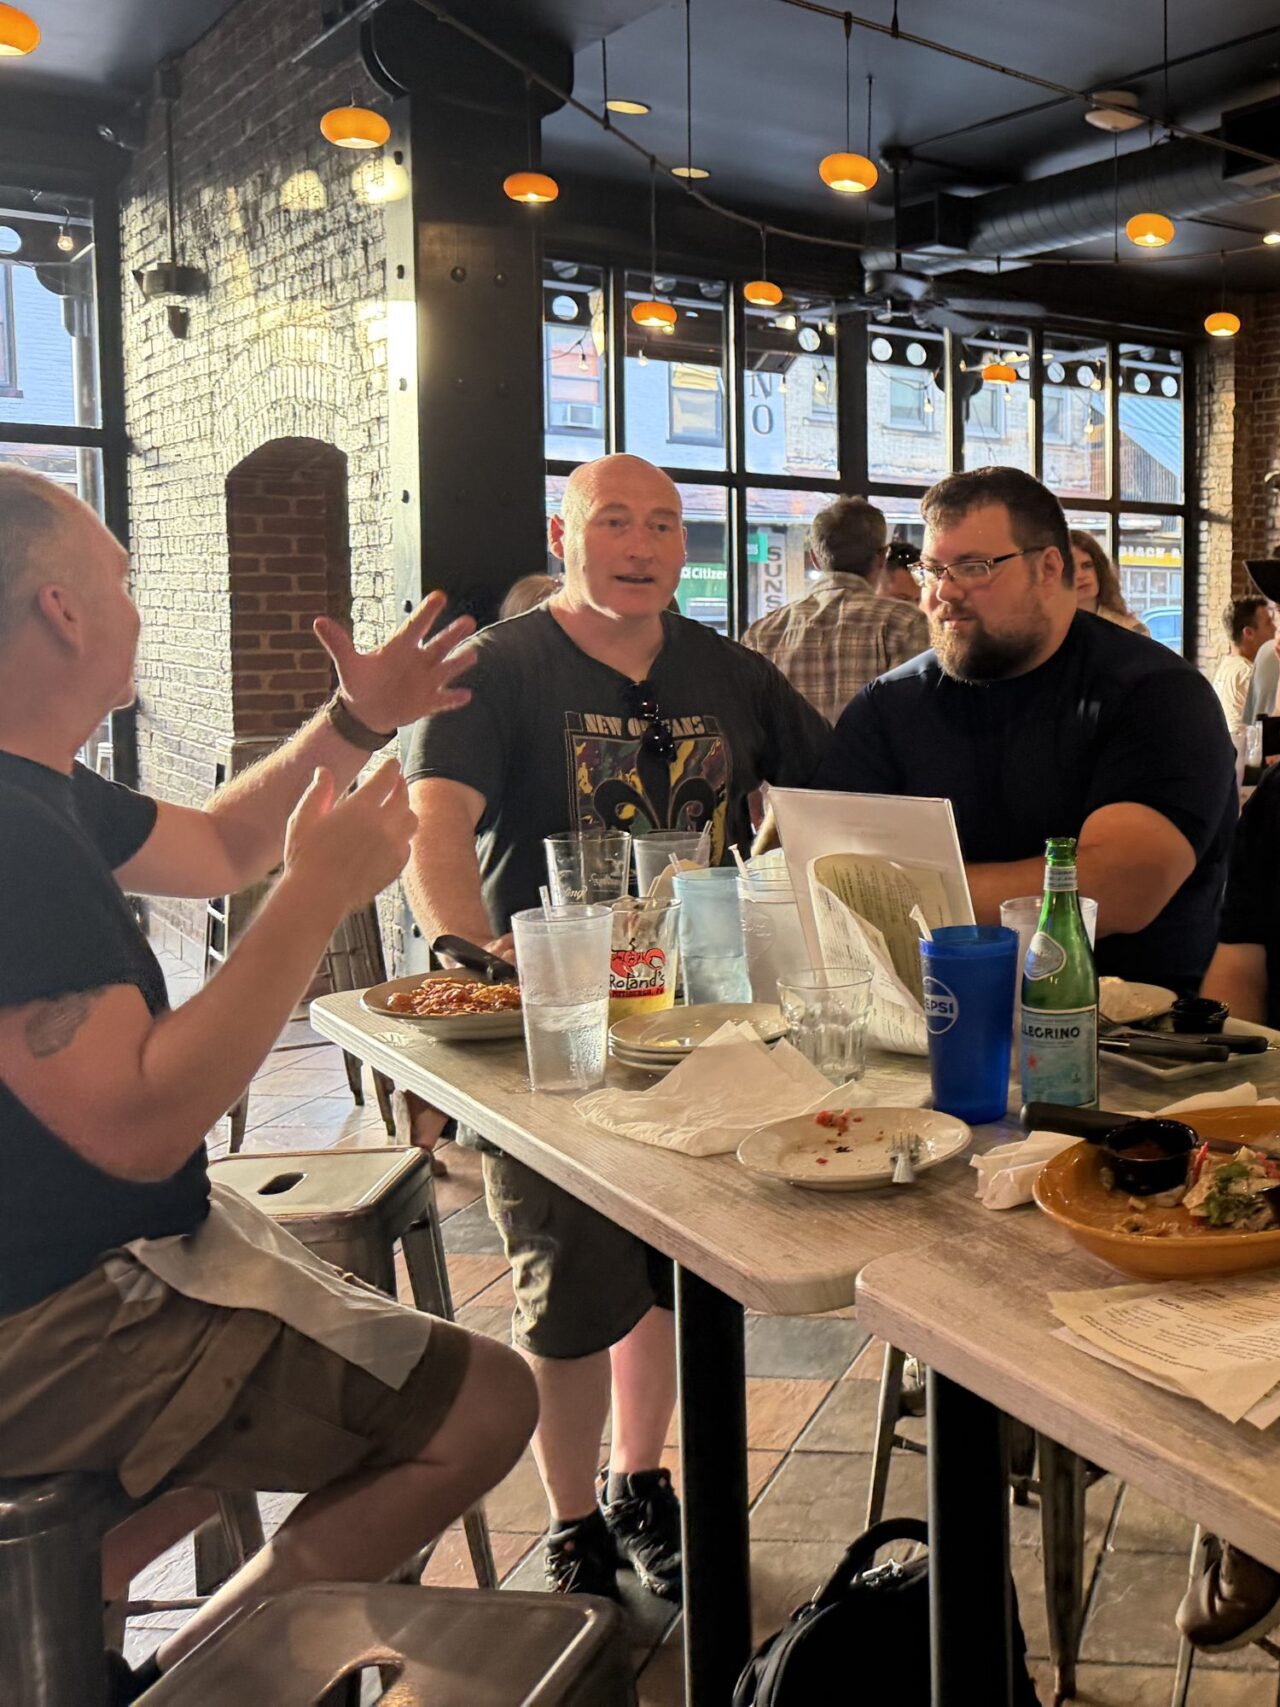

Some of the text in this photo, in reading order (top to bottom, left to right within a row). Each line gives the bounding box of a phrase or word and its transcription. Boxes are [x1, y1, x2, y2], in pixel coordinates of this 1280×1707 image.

[583, 713, 706, 738] NEW OANS
[609, 969, 665, 991] Roland's
[924, 997, 955, 1015] EPSI
